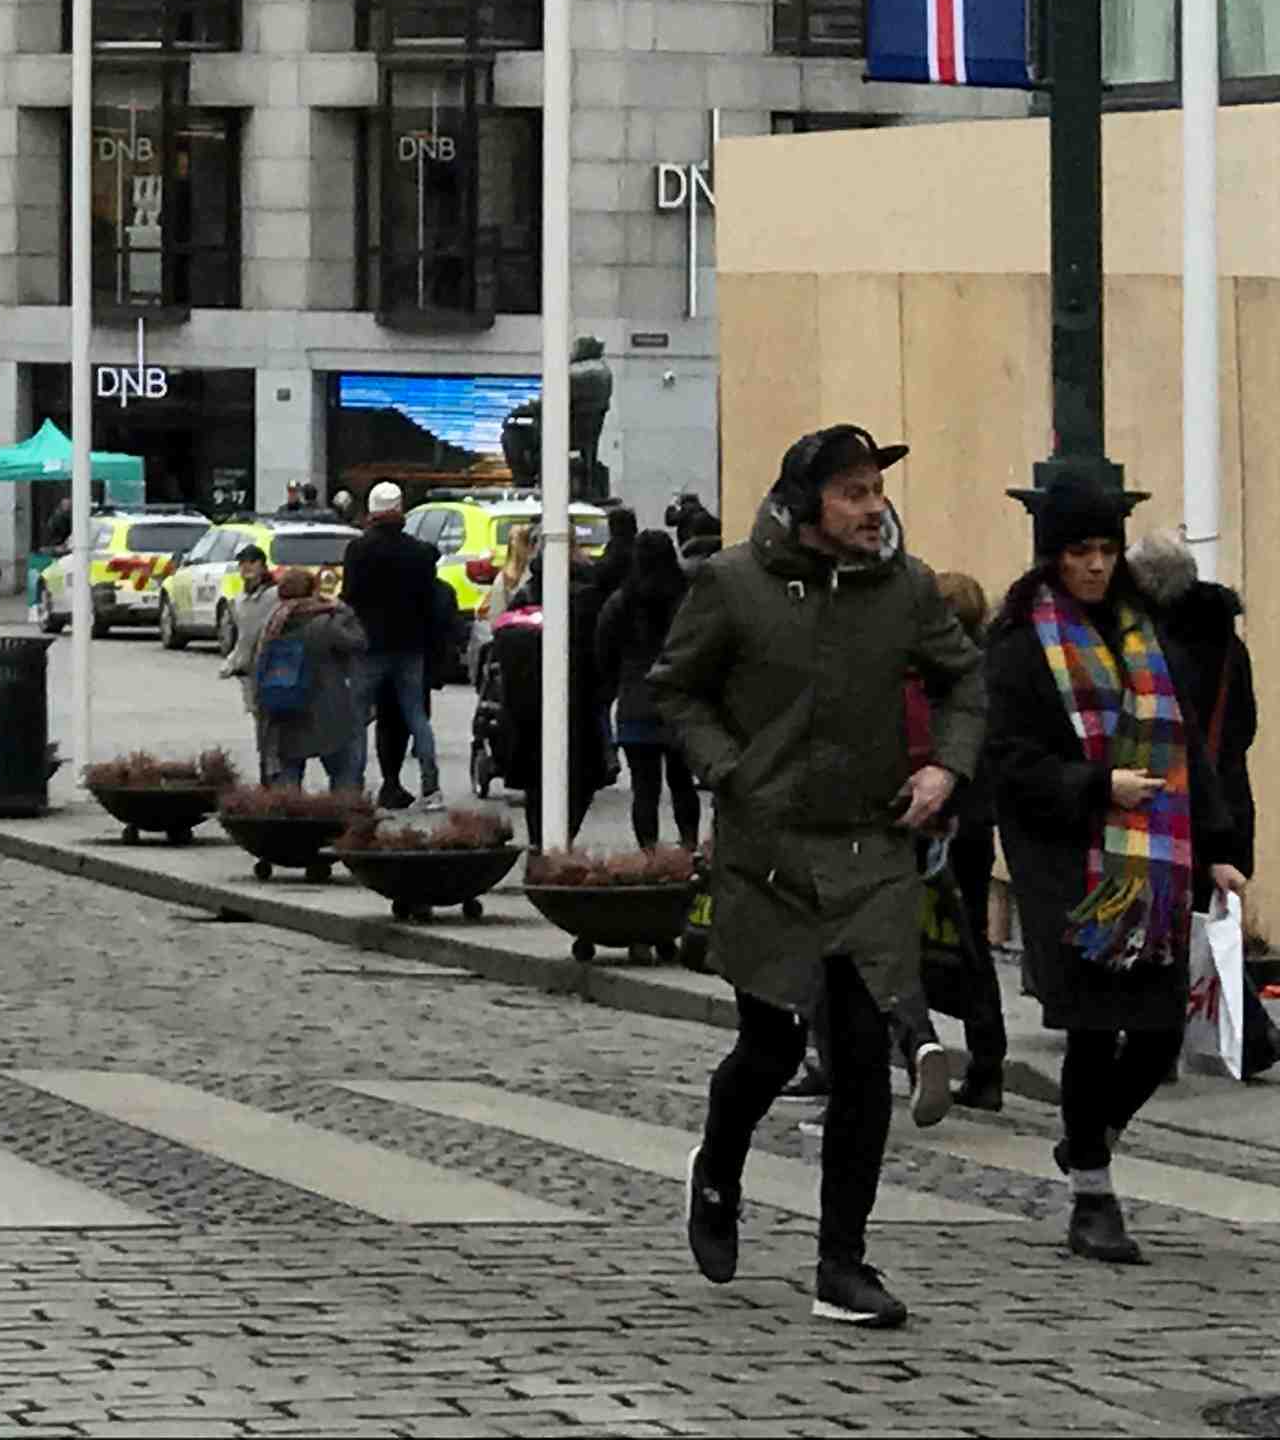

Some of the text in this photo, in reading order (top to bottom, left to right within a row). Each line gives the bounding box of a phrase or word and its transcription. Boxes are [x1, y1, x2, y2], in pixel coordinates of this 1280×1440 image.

[99, 137, 153, 161] DNB
[399, 136, 456, 160] DNB
[97, 366, 168, 408] DNB
